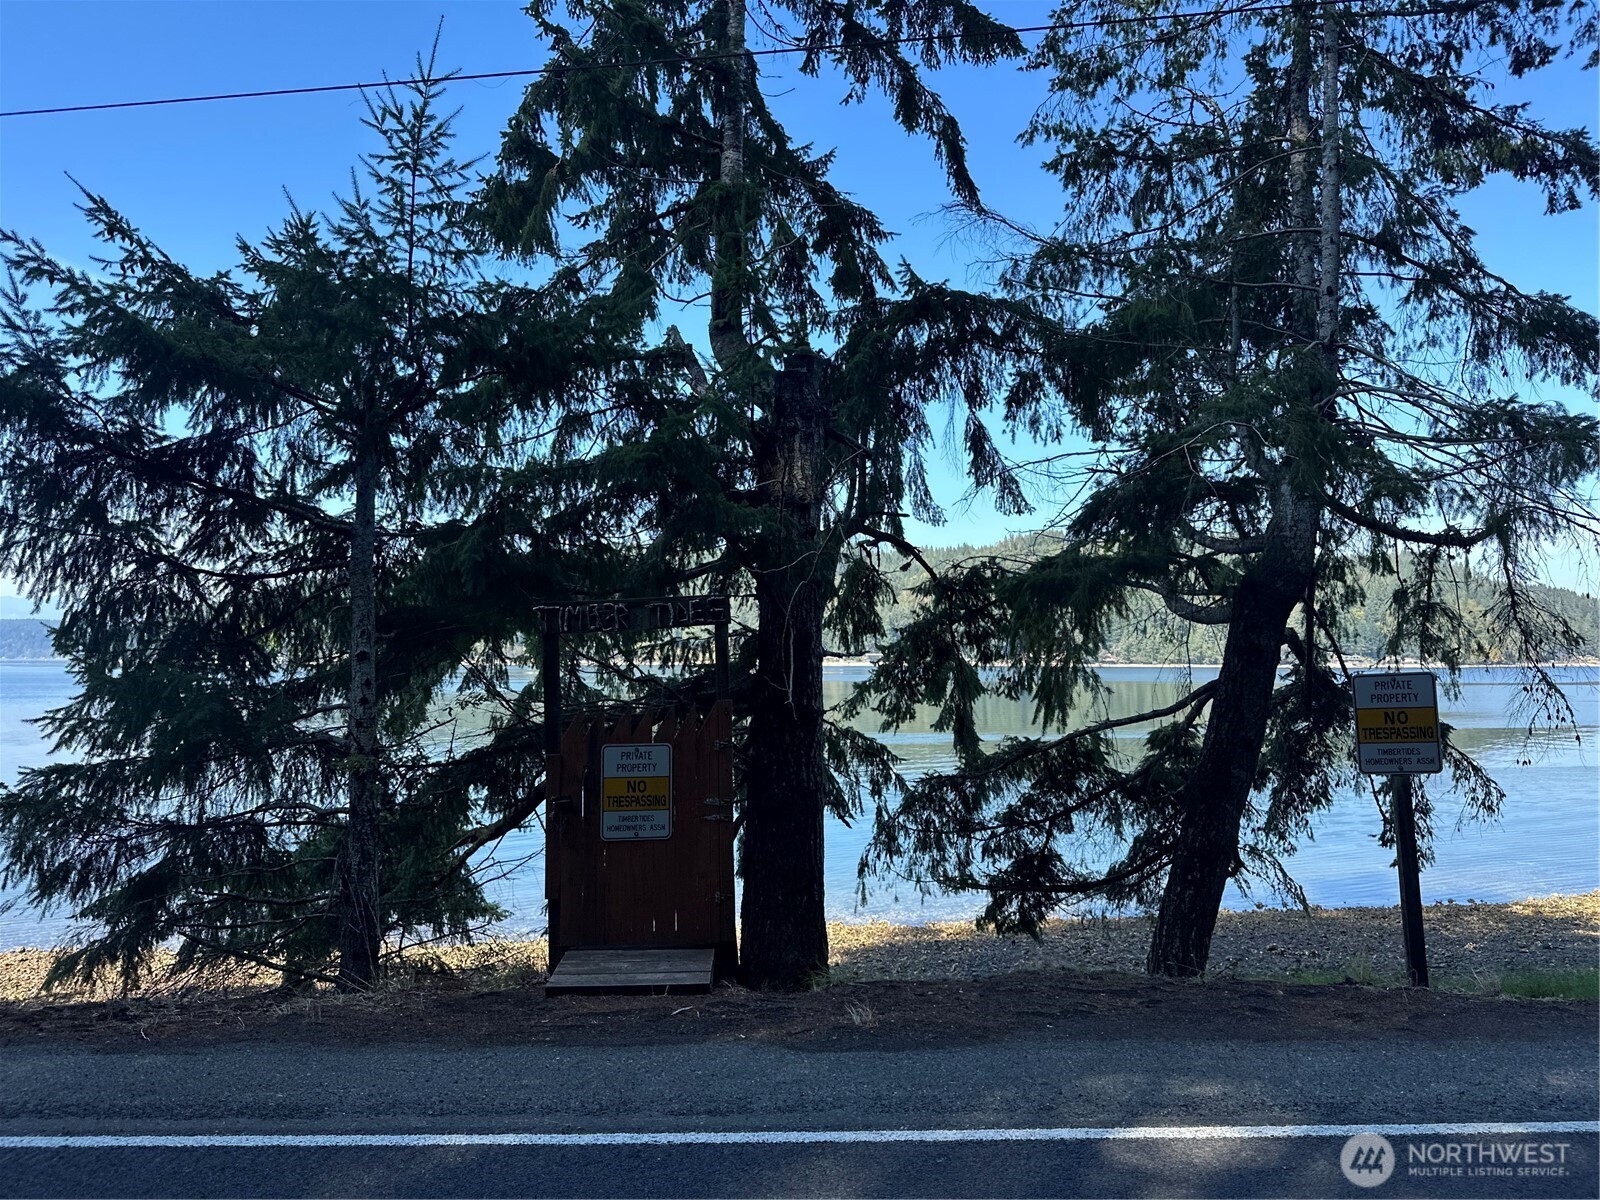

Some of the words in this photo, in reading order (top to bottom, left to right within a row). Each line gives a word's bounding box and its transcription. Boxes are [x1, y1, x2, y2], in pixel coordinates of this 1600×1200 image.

[532, 602, 629, 632] TIMBER
[644, 596, 727, 626] TIDES
[1374, 680, 1413, 691] PRIVATE
[1370, 693, 1419, 703] PROPERTY
[1383, 711, 1408, 725] NO
[1361, 726, 1434, 740] TRESPASSING
[620, 751, 653, 761] PRIVATE
[1365, 758, 1413, 766] HOMEOWNERS
[1416, 757, 1435, 765] ASSN
[616, 763, 658, 773] PROPERTY
[627, 780, 647, 793] NO
[606, 795, 667, 807] TRESPASSING
[606, 825, 647, 833] HOMEOWNERS
